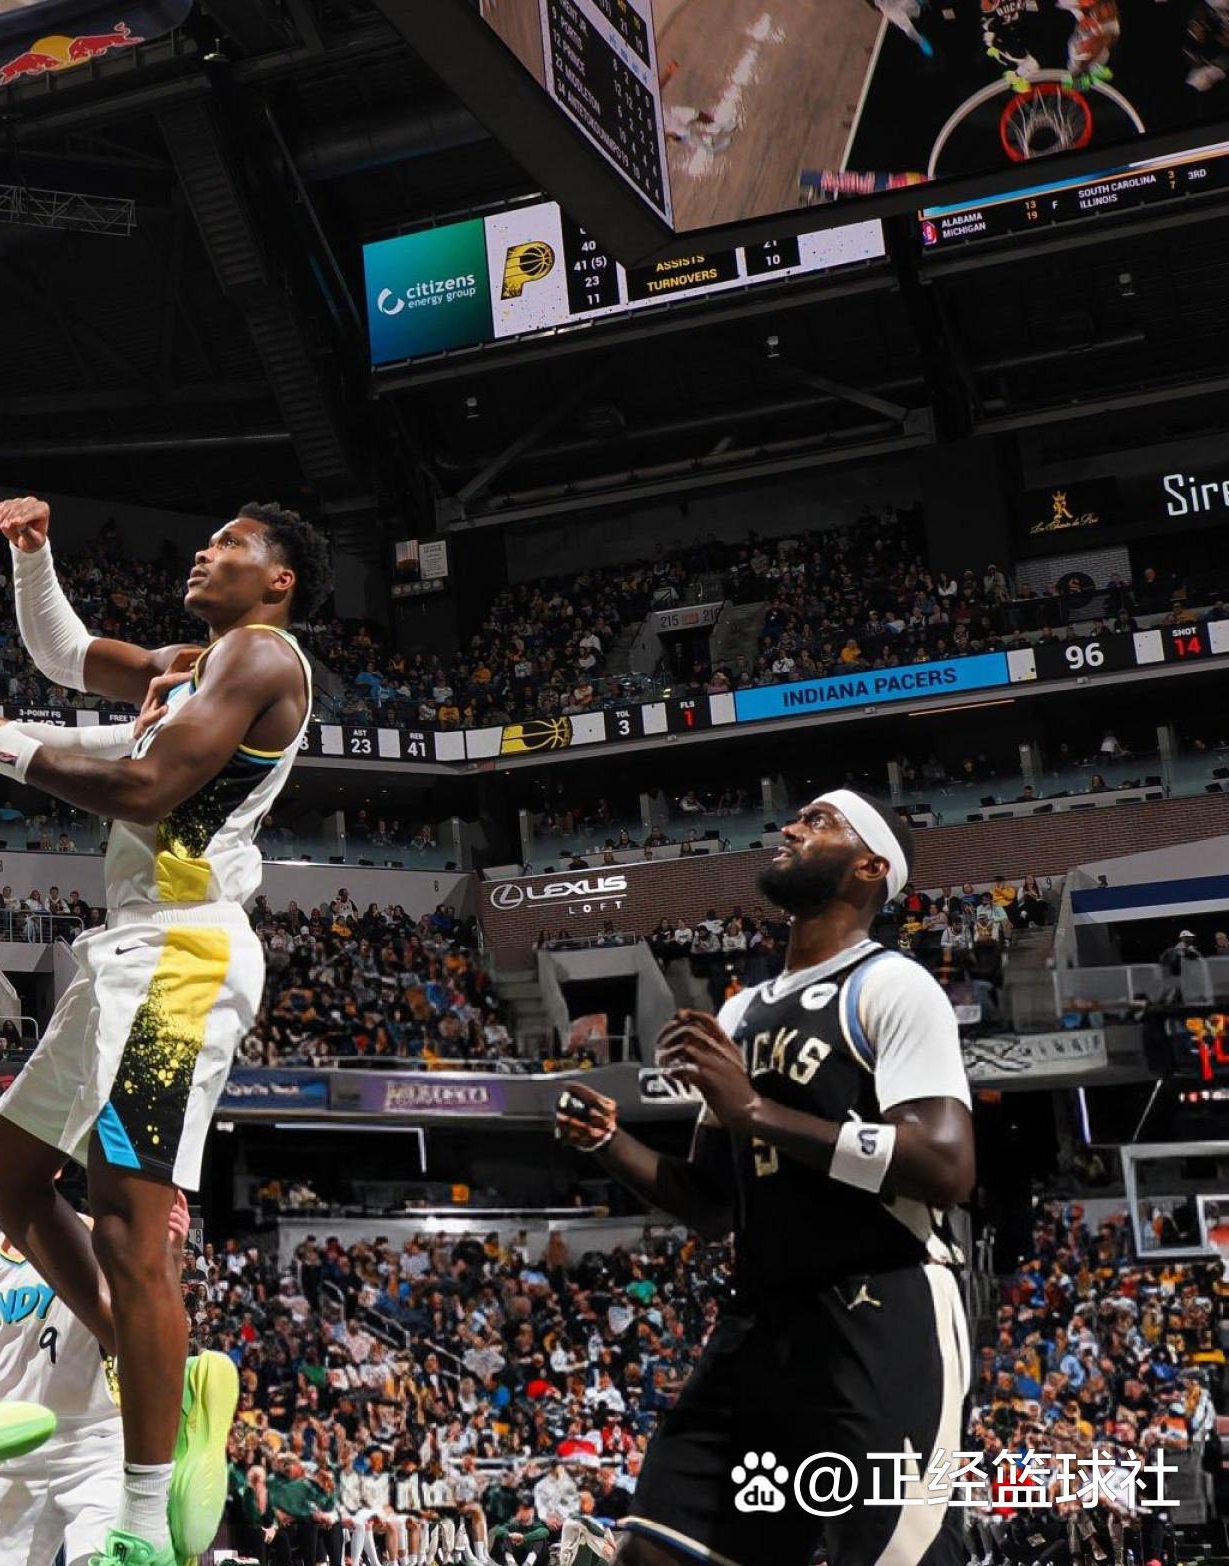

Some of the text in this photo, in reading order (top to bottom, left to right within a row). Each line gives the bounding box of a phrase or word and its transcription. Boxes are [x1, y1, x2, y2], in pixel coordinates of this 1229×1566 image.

[1187, 168, 1207, 180] 3RD
[1078, 174, 1157, 199] SOUTH CAROLINA
[1079, 194, 1118, 210] ILLINOIS
[941, 212, 983, 229] ALABAMA
[942, 221, 987, 239] MICHIGAN
[581, 240, 596, 252] 40
[574, 254, 607, 271] 41 (5)
[765, 253, 781, 266] 10
[406, 274, 476, 299] citizens
[585, 275, 600, 288] 23
[646, 268, 718, 293] TURNOVERS
[407, 287, 476, 309] energy group
[587, 293, 600, 305] 11
[1172, 626, 1197, 637] SHOT
[1174, 636, 1202, 656] 14
[1064, 641, 1104, 670] 96
[782, 667, 958, 708] INDIANA PACERS
[19, 708, 50, 718] 3-POINT
[618, 719, 630, 735] 3
[350, 738, 372, 754] 23
[407, 741, 426, 757] 41
[526, 875, 628, 899] LEXUS
[568, 900, 624, 915] LOFT
[741, 1026, 833, 1085] CKS
[39, 1326, 58, 1365] 9
